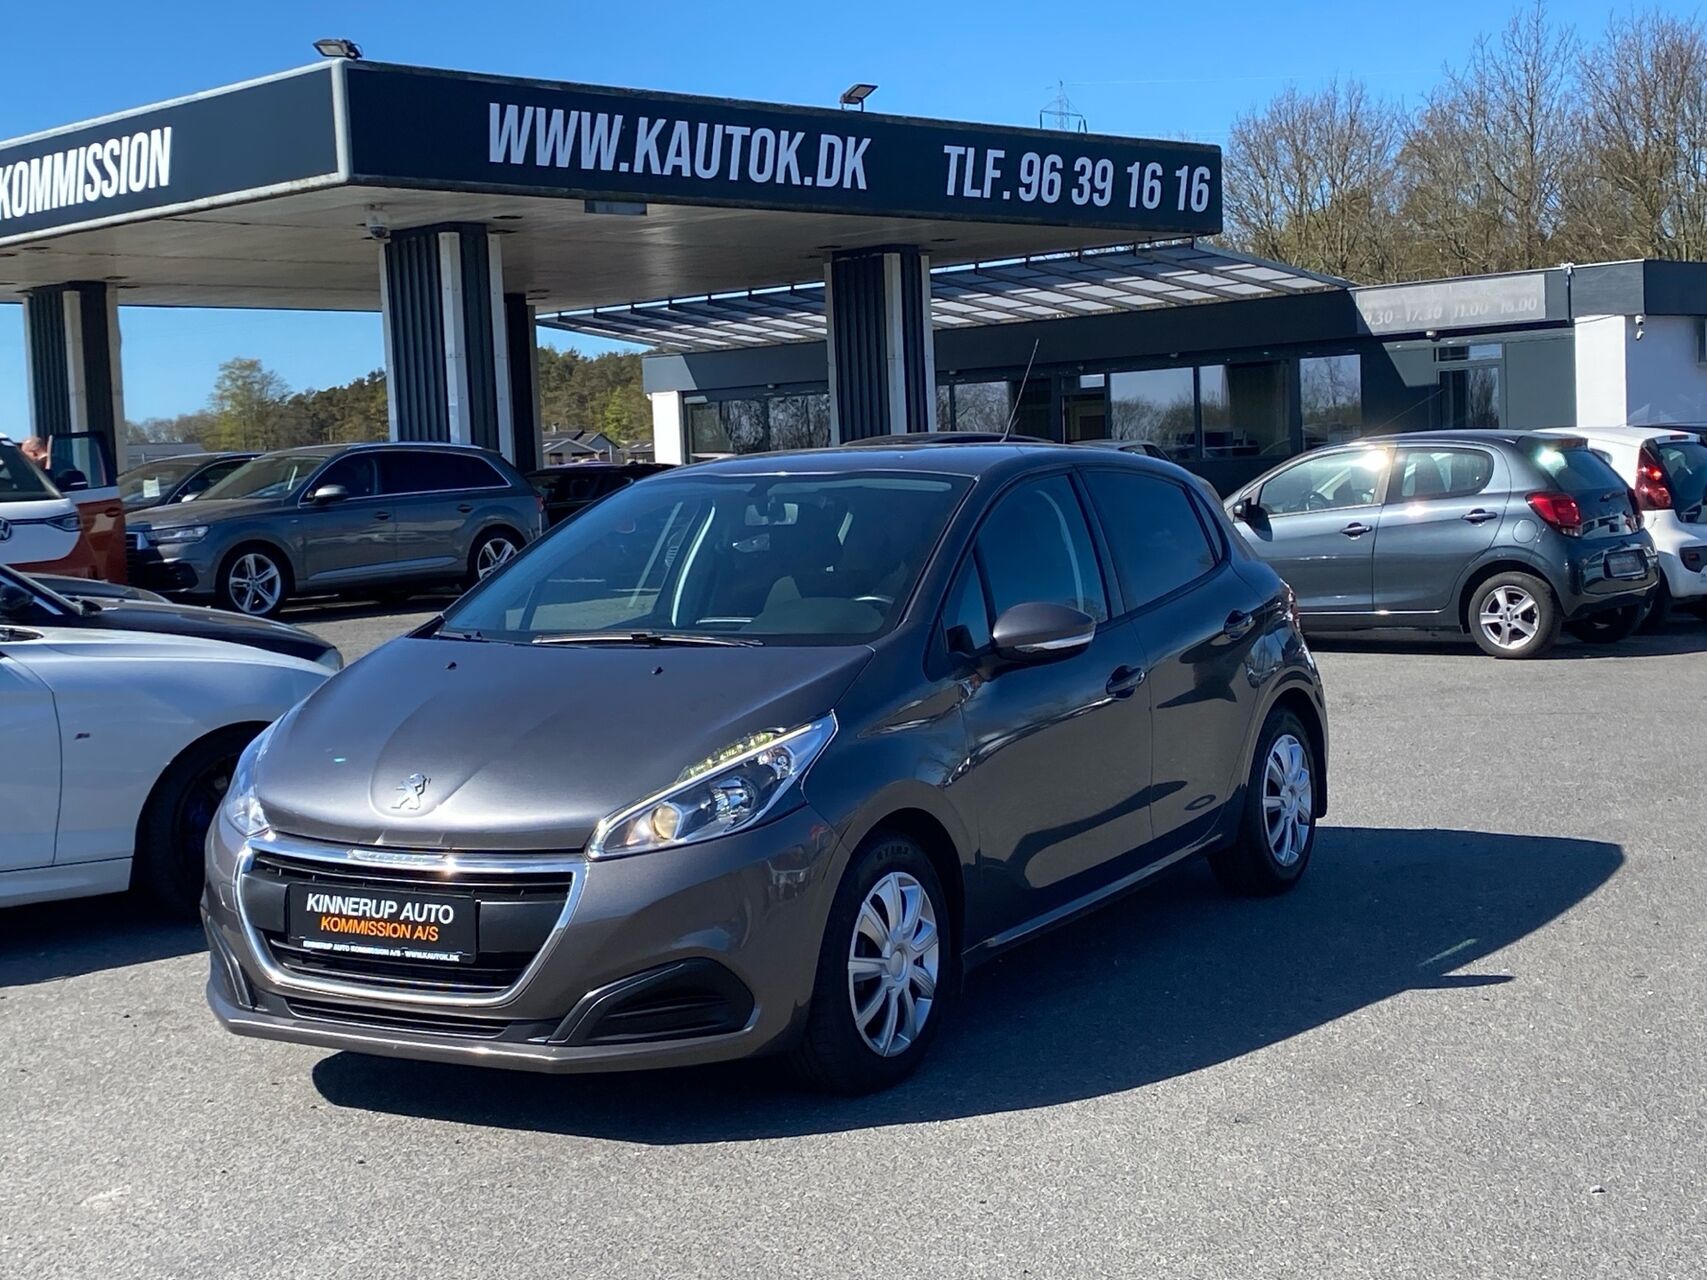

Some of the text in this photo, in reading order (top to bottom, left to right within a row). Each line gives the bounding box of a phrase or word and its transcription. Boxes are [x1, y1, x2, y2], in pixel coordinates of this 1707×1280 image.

[0, 126, 172, 221] KOMMISSION
[488, 102, 872, 190] WWW.KAUTOK.DK
[943, 145, 1211, 213] TLF. 96 39 16 16
[306, 893, 454, 924] KINNERUP AUTO
[320, 916, 439, 941] KOMMISSION A/S
